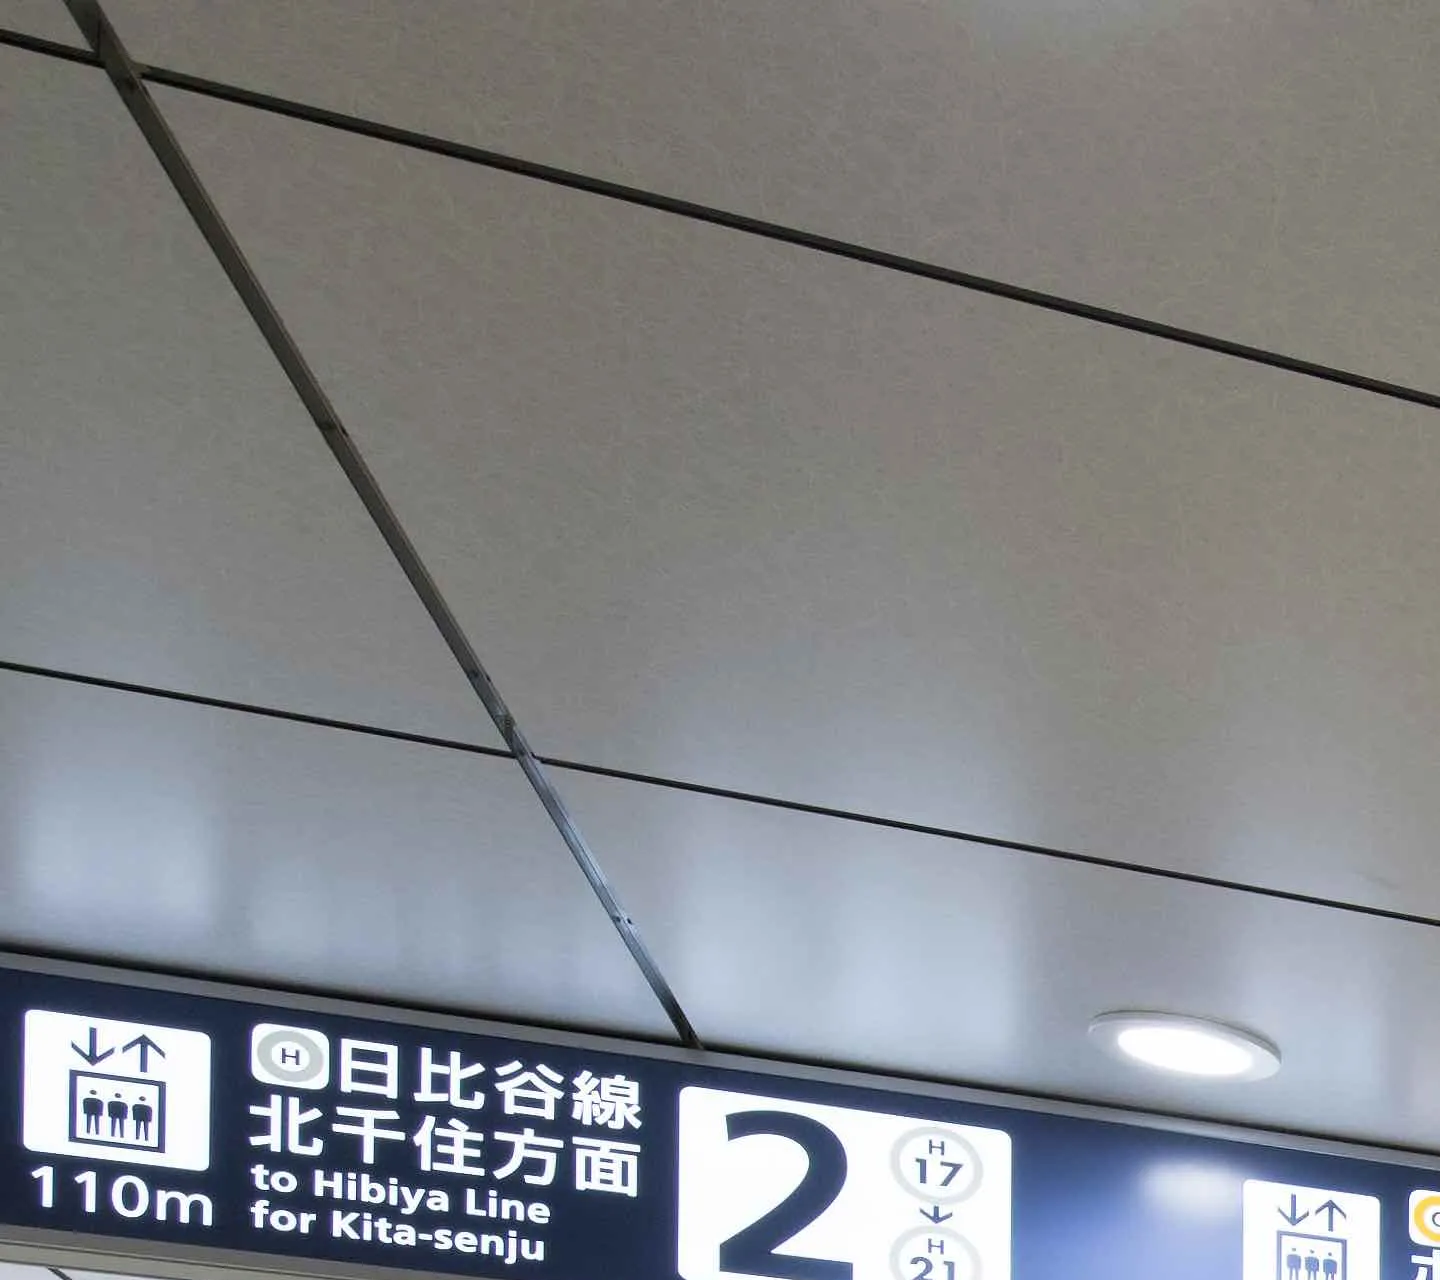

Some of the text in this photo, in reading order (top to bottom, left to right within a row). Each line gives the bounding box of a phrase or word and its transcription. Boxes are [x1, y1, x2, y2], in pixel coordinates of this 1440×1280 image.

[280, 1047, 300, 1067] H
[340, 1037, 643, 1131] 日比谷線
[249, 1094, 642, 1198] 北千住方面
[914, 1157, 964, 1187] 17
[928, 1138, 946, 1156] H
[30, 1165, 214, 1227] 110m
[250, 1163, 552, 1225] to Hibiya Line
[250, 1199, 546, 1266] for Kita-senju
[927, 1238, 945, 1256] H
